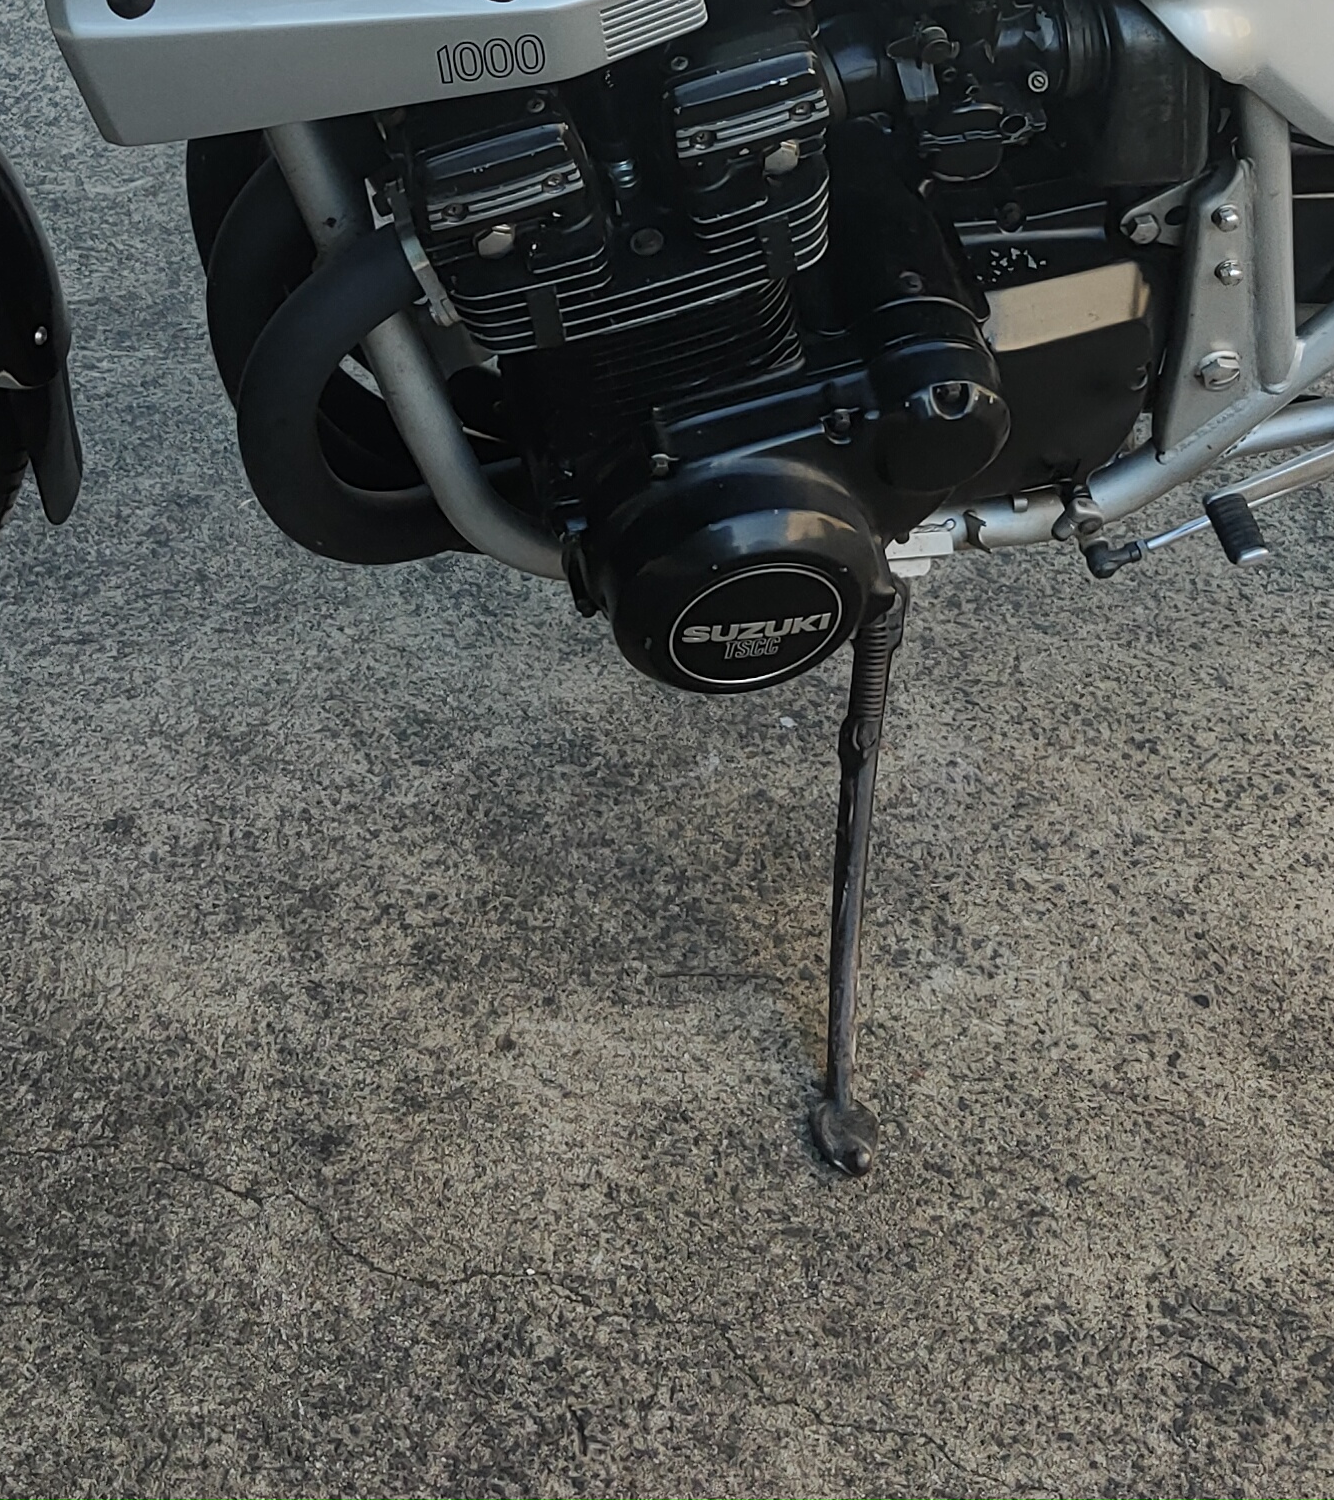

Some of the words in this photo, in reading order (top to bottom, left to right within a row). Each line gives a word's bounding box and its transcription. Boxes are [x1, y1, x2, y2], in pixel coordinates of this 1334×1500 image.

[435, 33, 546, 85] 1000
[681, 611, 832, 644] SUZUKI
[724, 636, 782, 660] TSCC
